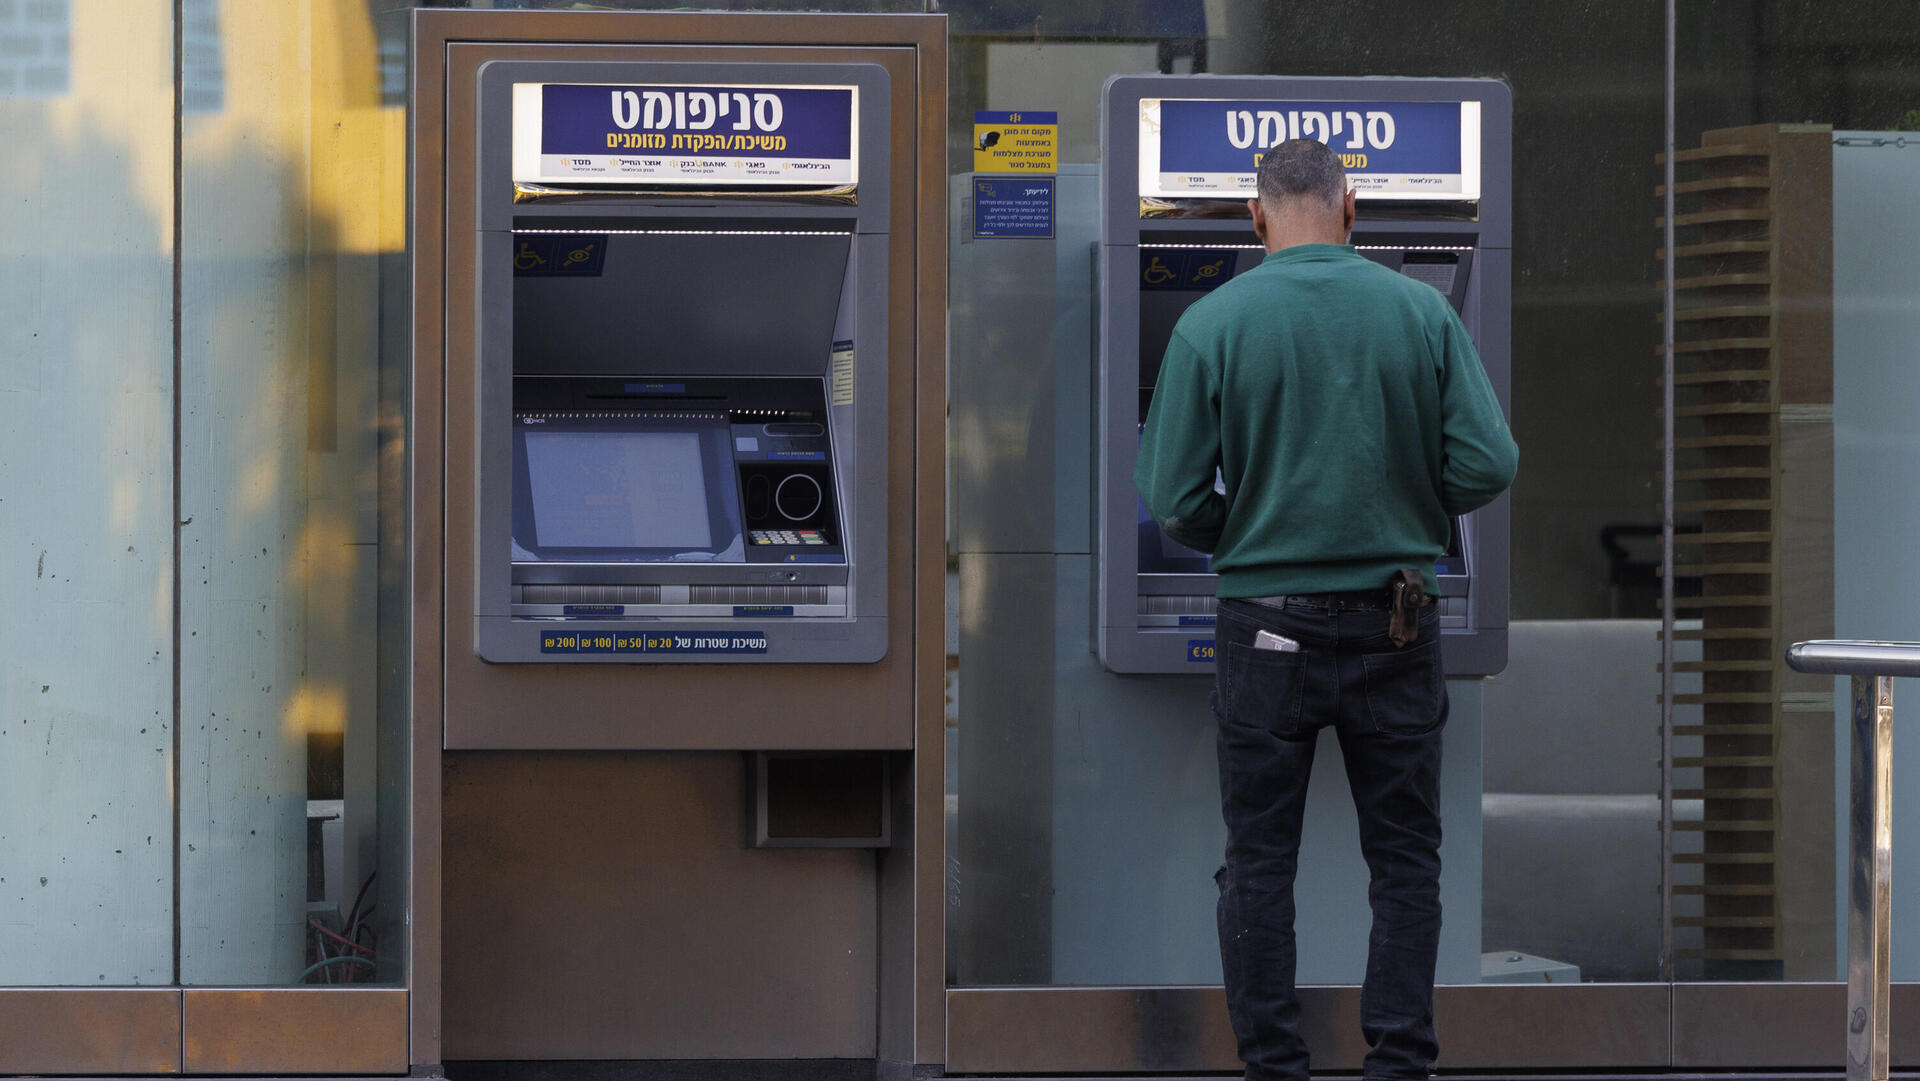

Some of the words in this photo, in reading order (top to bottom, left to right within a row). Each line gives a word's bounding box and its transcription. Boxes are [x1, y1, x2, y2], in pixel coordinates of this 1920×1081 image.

[611, 90, 784, 132] סניפומט
[1031, 128, 1051, 136] מקום
[1226, 110, 1396, 150] סניפומט
[606, 132, 666, 149] מזומנים
[671, 133, 787, 153] משיכת/הפקדת
[993, 150, 1023, 158] מצלמות
[556, 637, 575, 648] 200
[594, 637, 612, 649] 100
[629, 637, 642, 649] 50
[659, 637, 672, 649] 20
[674, 635, 691, 649] של
[694, 637, 729, 649] שטרות
[732, 638, 768, 649] משיכת
[1201, 647, 1214, 658] 50
